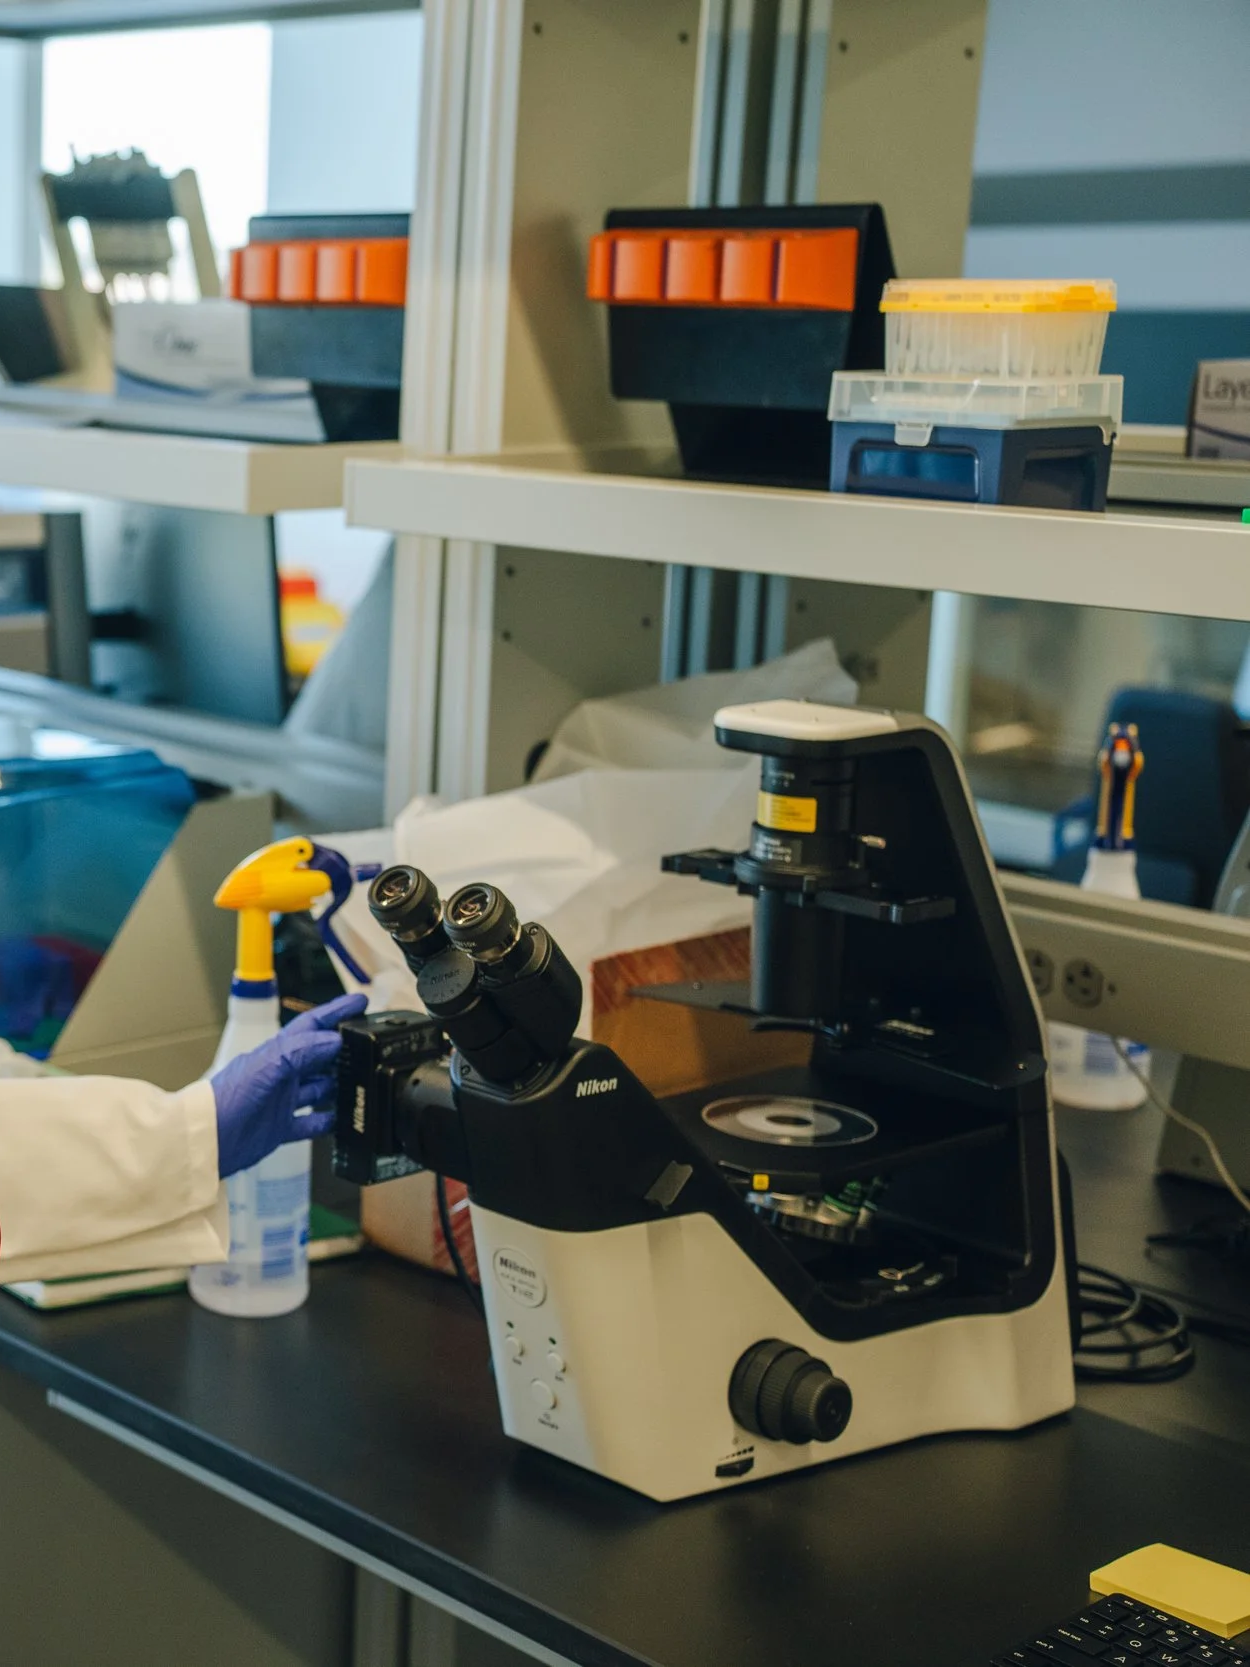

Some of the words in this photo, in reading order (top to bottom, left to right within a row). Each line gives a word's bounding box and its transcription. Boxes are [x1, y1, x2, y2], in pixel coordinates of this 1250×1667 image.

[575, 1077, 618, 1098] Nikon
[353, 1085, 366, 1134] Nikon
[1129, 1639, 1142, 1648] Q
[1113, 1656, 1126, 1664] A
[1161, 1653, 1179, 1663] W
